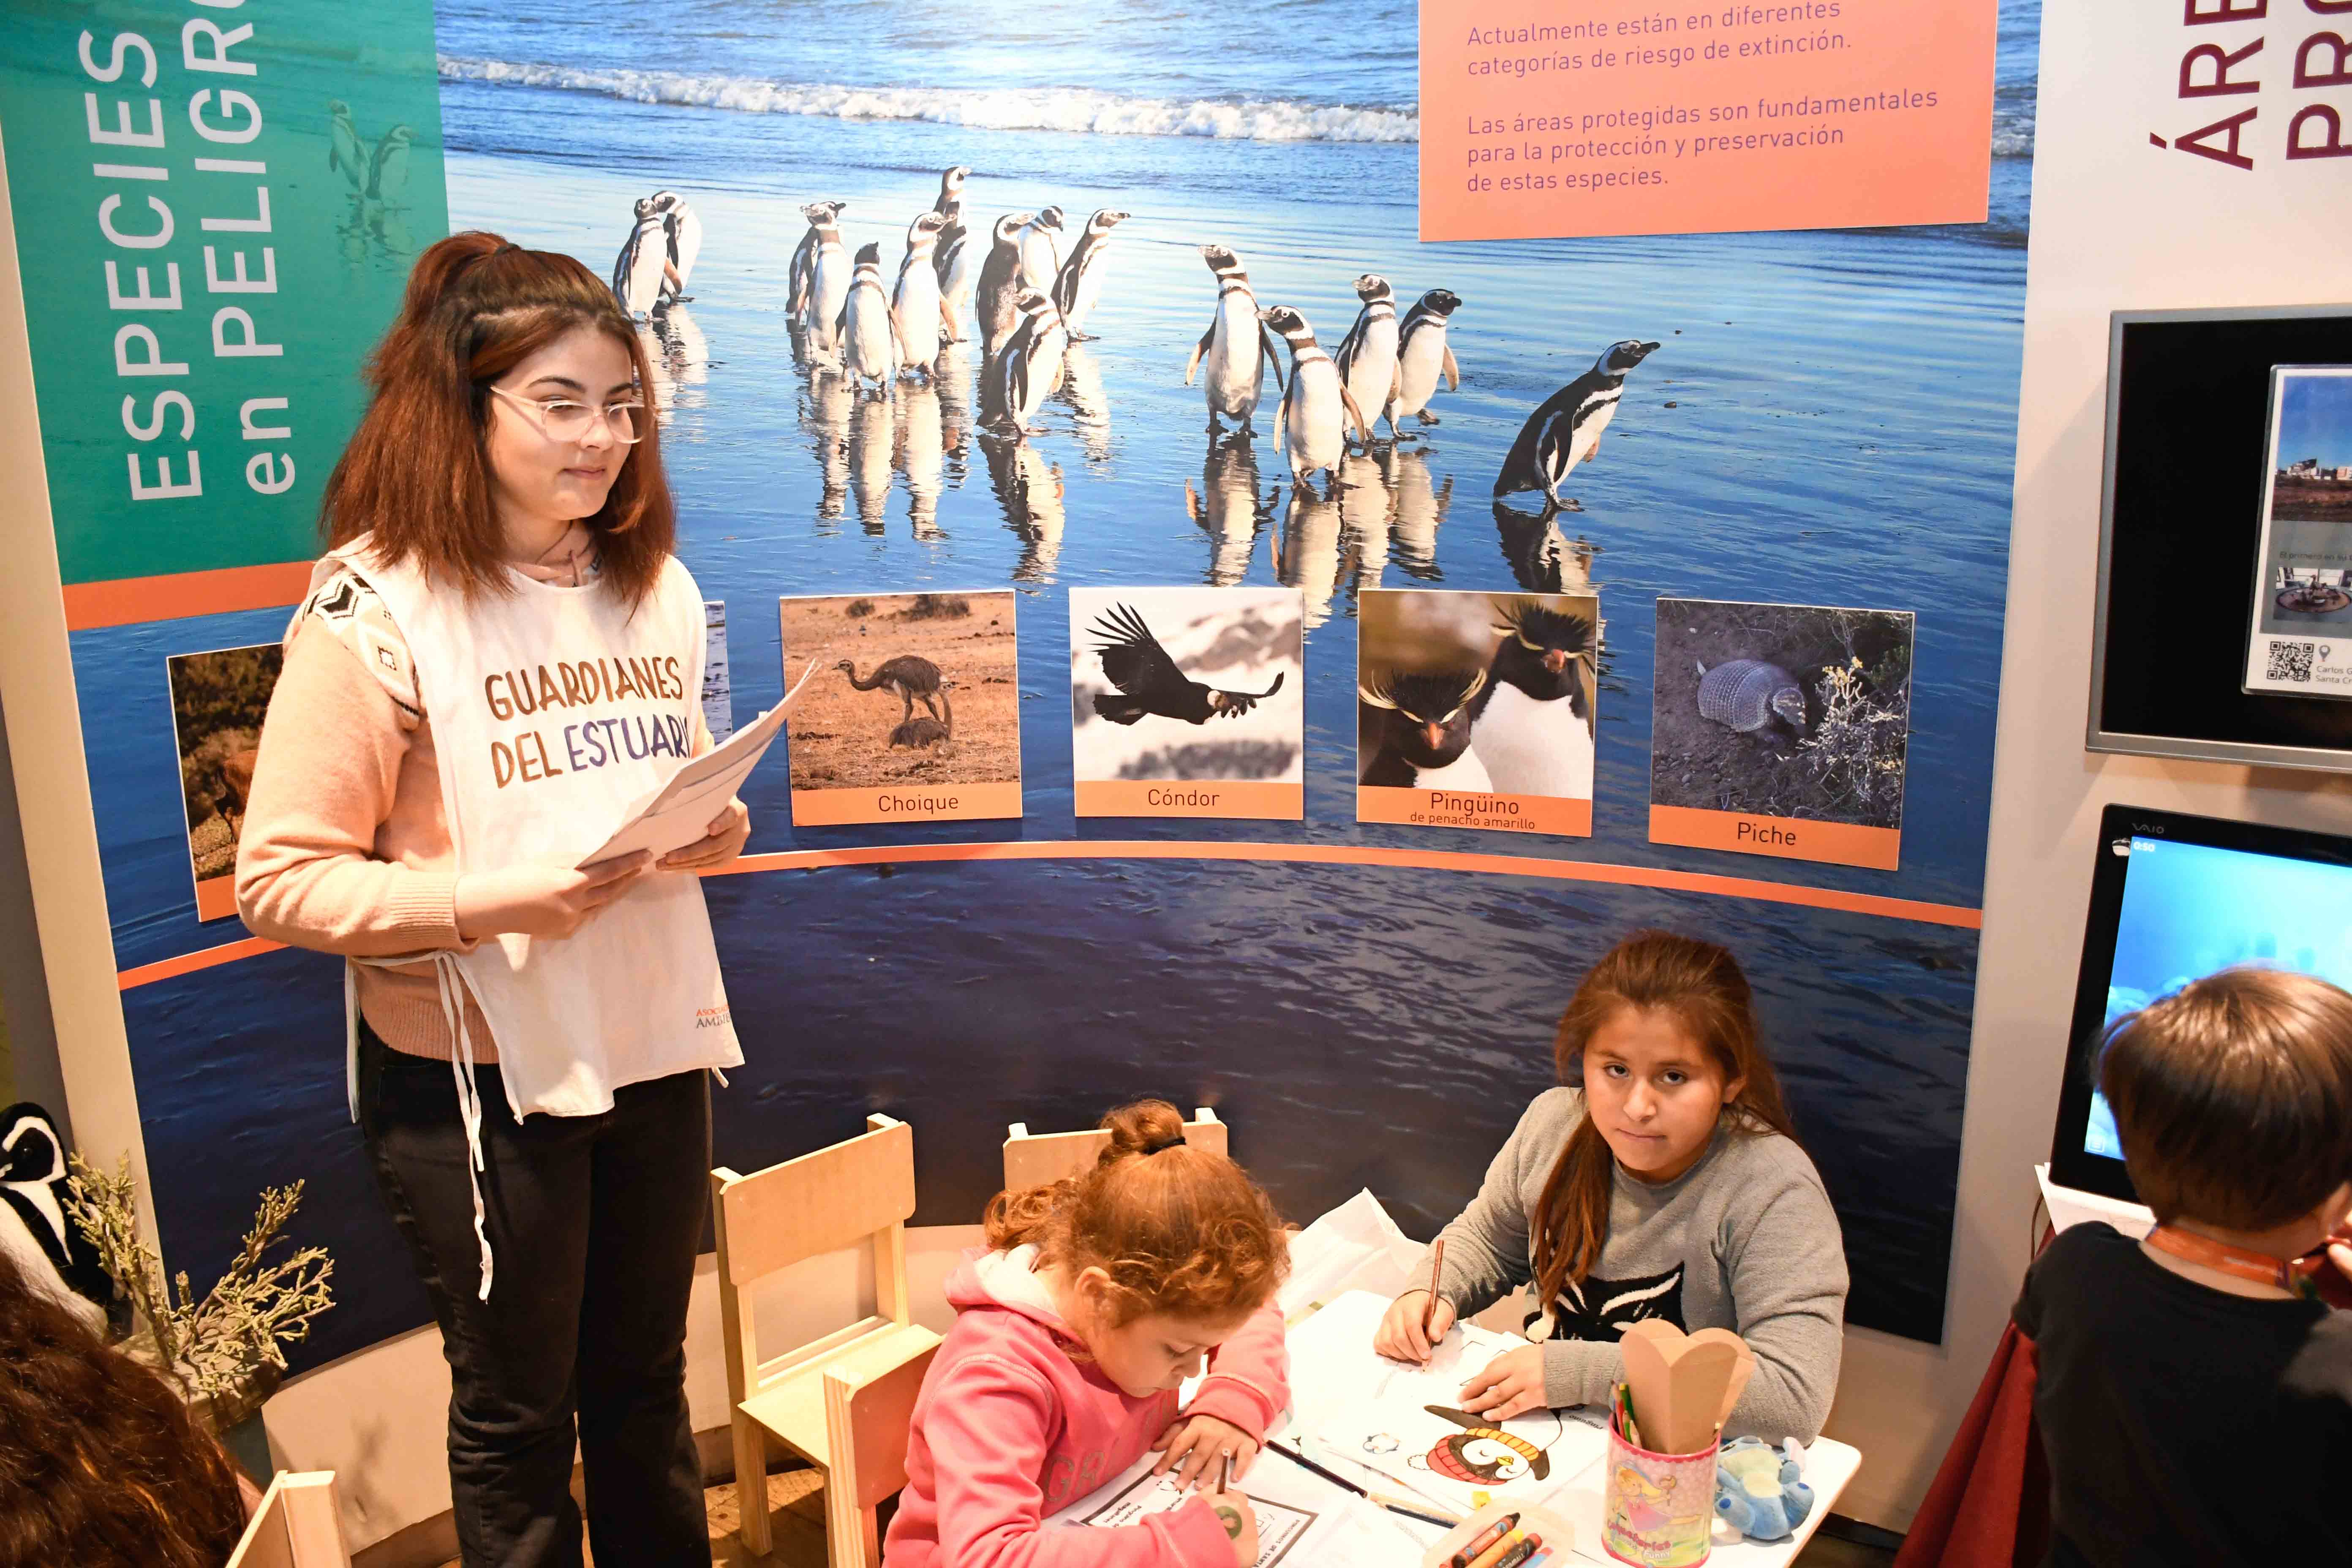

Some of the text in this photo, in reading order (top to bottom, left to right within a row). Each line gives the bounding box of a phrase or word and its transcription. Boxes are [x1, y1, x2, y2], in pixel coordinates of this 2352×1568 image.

[1467, 1, 1840, 45] Actualmente están en diferentes
[1468, 29, 1851, 78] categorías de riesgo de extinción.
[2286, 0, 2352, 160] PR
[1468, 88, 1938, 134] Las áreas protegidas son fundamentales
[1468, 124, 1843, 168] para la protección y preservación
[1467, 166, 1669, 192] de estas especies.
[182, 0, 295, 495] en PELIGR
[79, 29, 202, 500] ESPECIES
[2315, 674, 2340, 683] Santa
[2317, 665, 2344, 674] Carlos
[485, 656, 683, 721] GUARDIANES
[491, 731, 563, 789] DEL
[879, 794, 958, 815] Choique
[1148, 788, 1220, 806] Cóndor
[1430, 792, 1519, 817] Pingüino
[1410, 811, 1535, 830] de penacho amarillo
[2132, 822, 2164, 834] VAIO
[1737, 822, 1796, 846] Piche
[2133, 841, 2156, 852] 0:50
